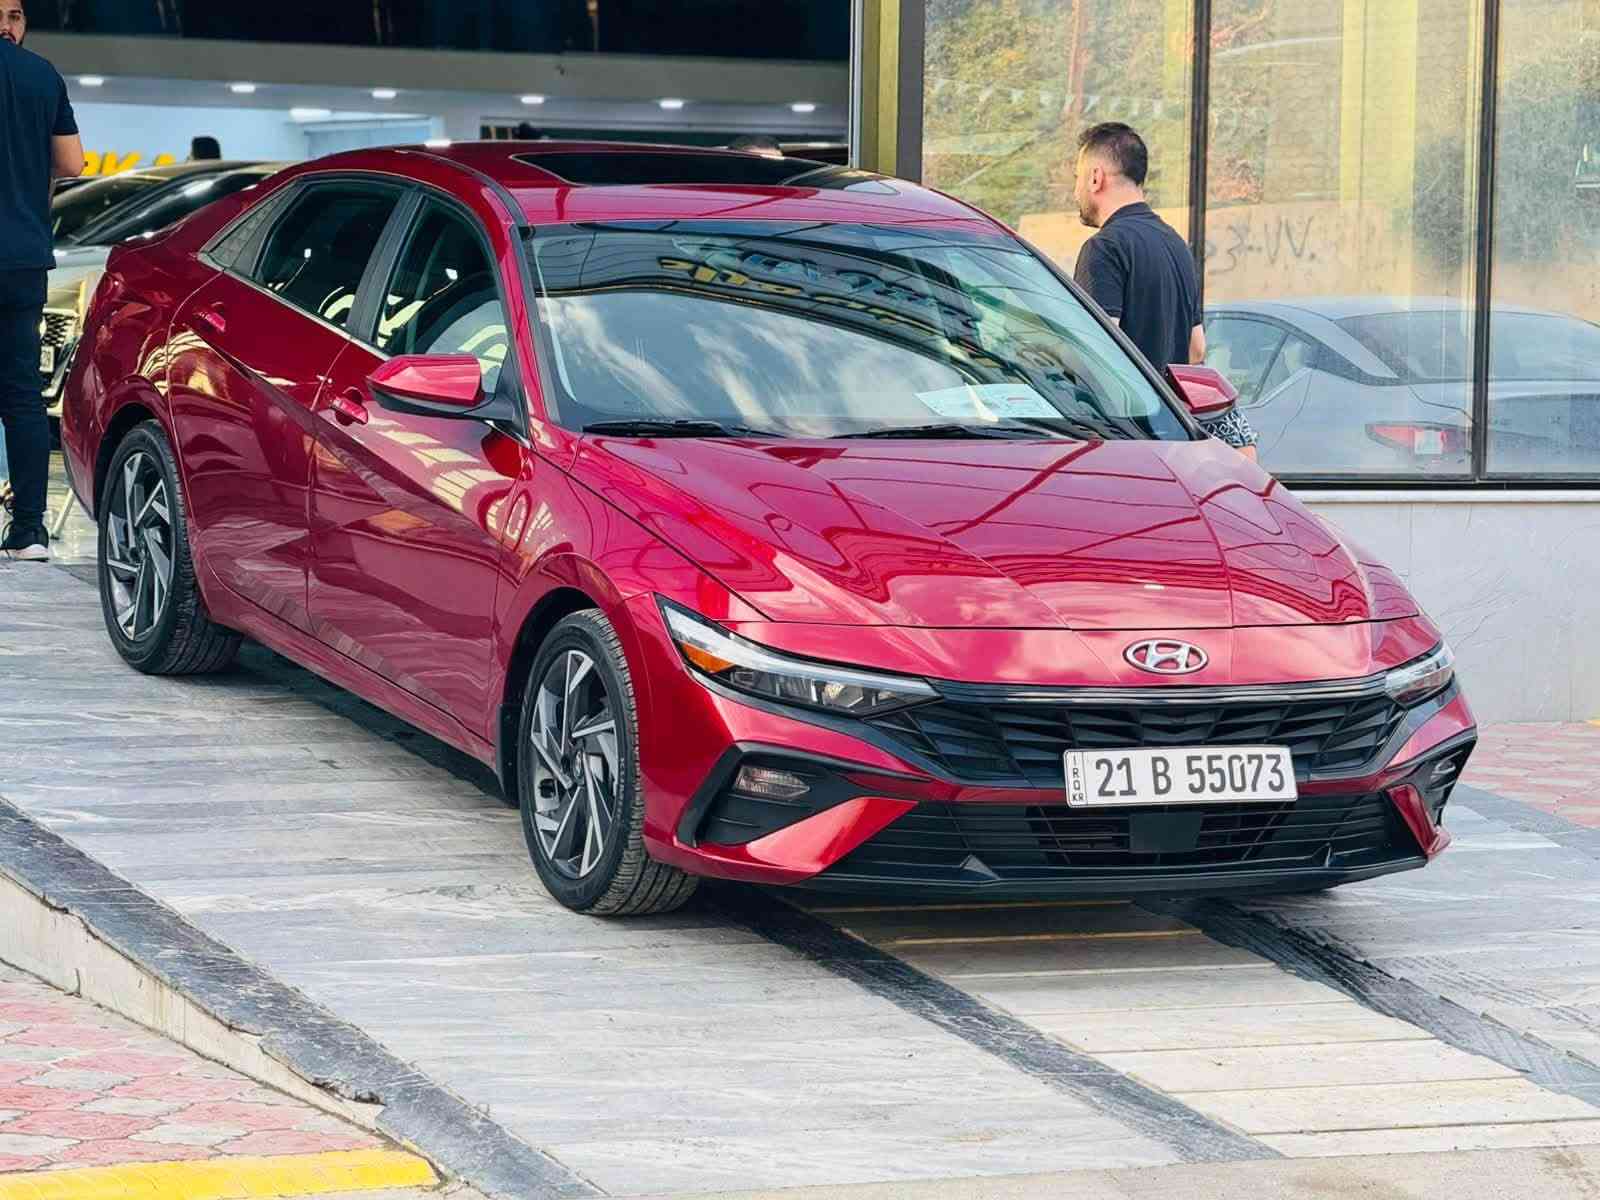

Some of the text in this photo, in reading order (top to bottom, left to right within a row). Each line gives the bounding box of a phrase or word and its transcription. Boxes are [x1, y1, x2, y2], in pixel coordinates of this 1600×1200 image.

[1095, 754, 1285, 797] 21 B 55073
